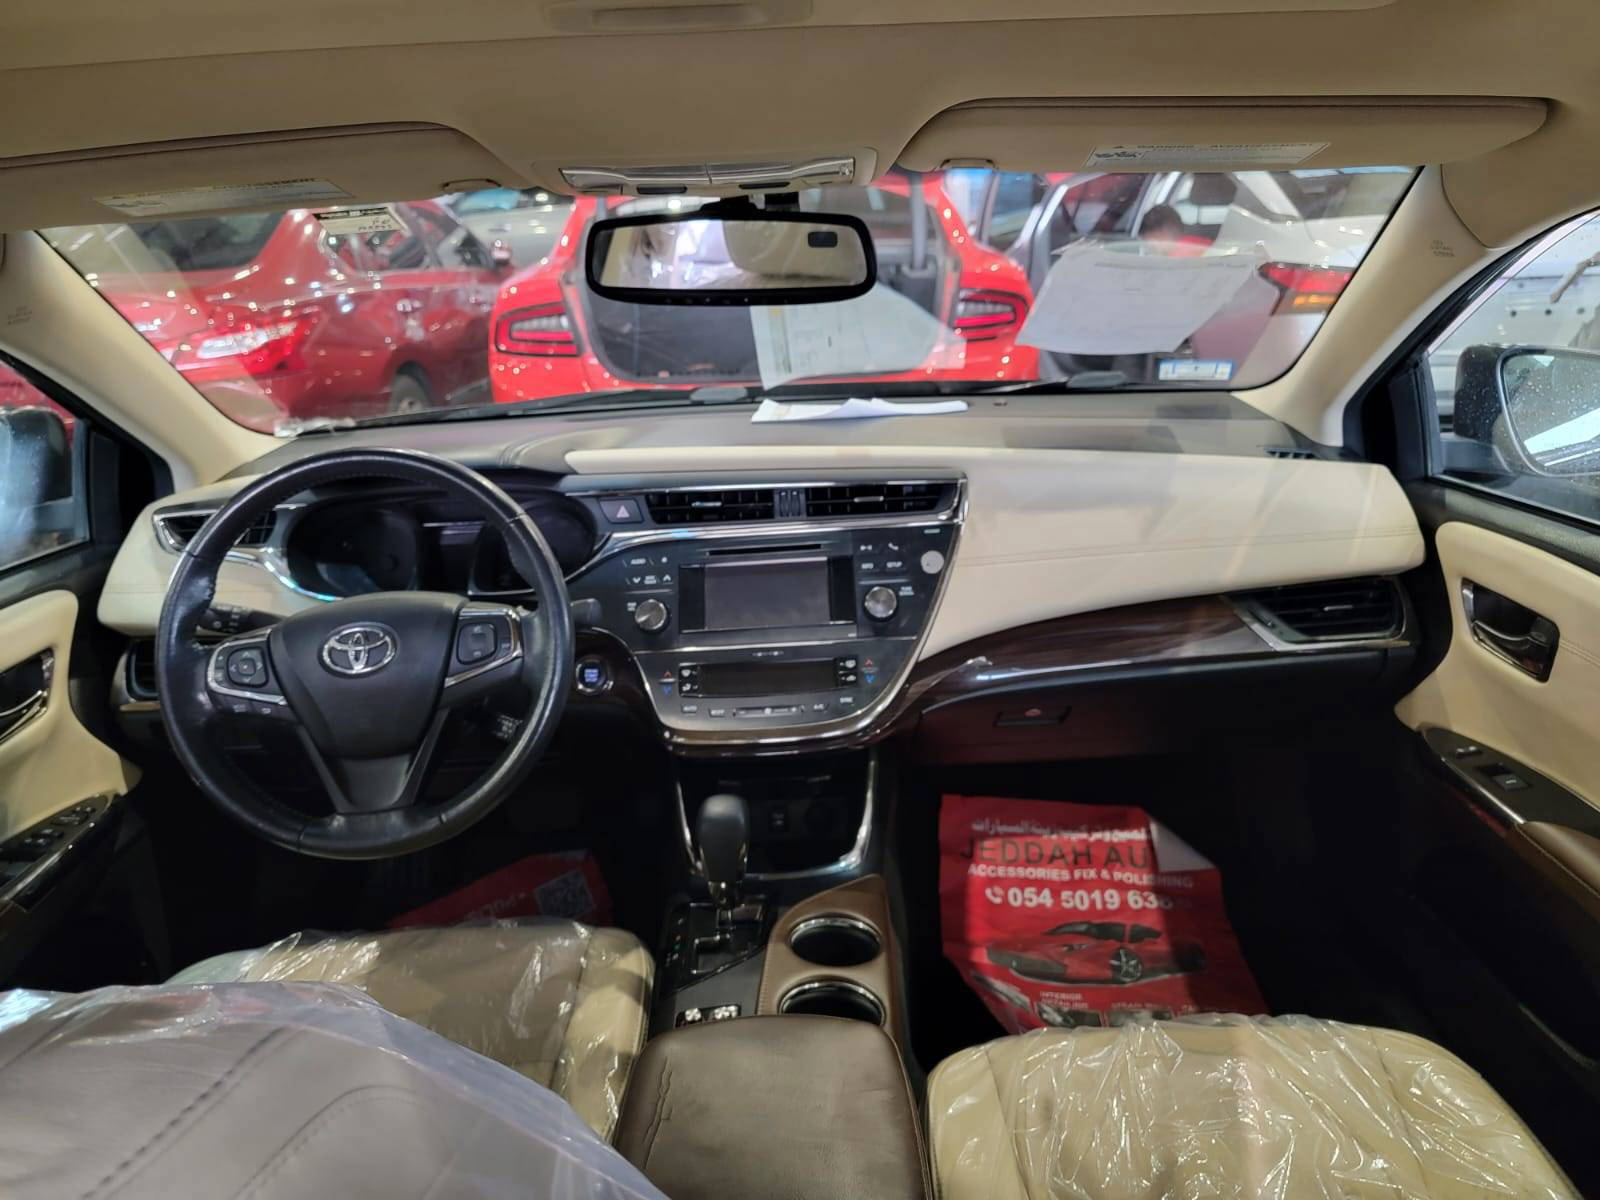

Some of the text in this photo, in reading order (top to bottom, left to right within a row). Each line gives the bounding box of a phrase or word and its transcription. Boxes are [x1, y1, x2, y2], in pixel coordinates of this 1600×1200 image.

[961, 837, 1092, 866] JEDDAH
[968, 863, 1070, 882] ACCESSORIES
[1074, 867, 1098, 881] FIX
[1007, 886, 1054, 908] 054
[1061, 889, 1121, 911] 5019
